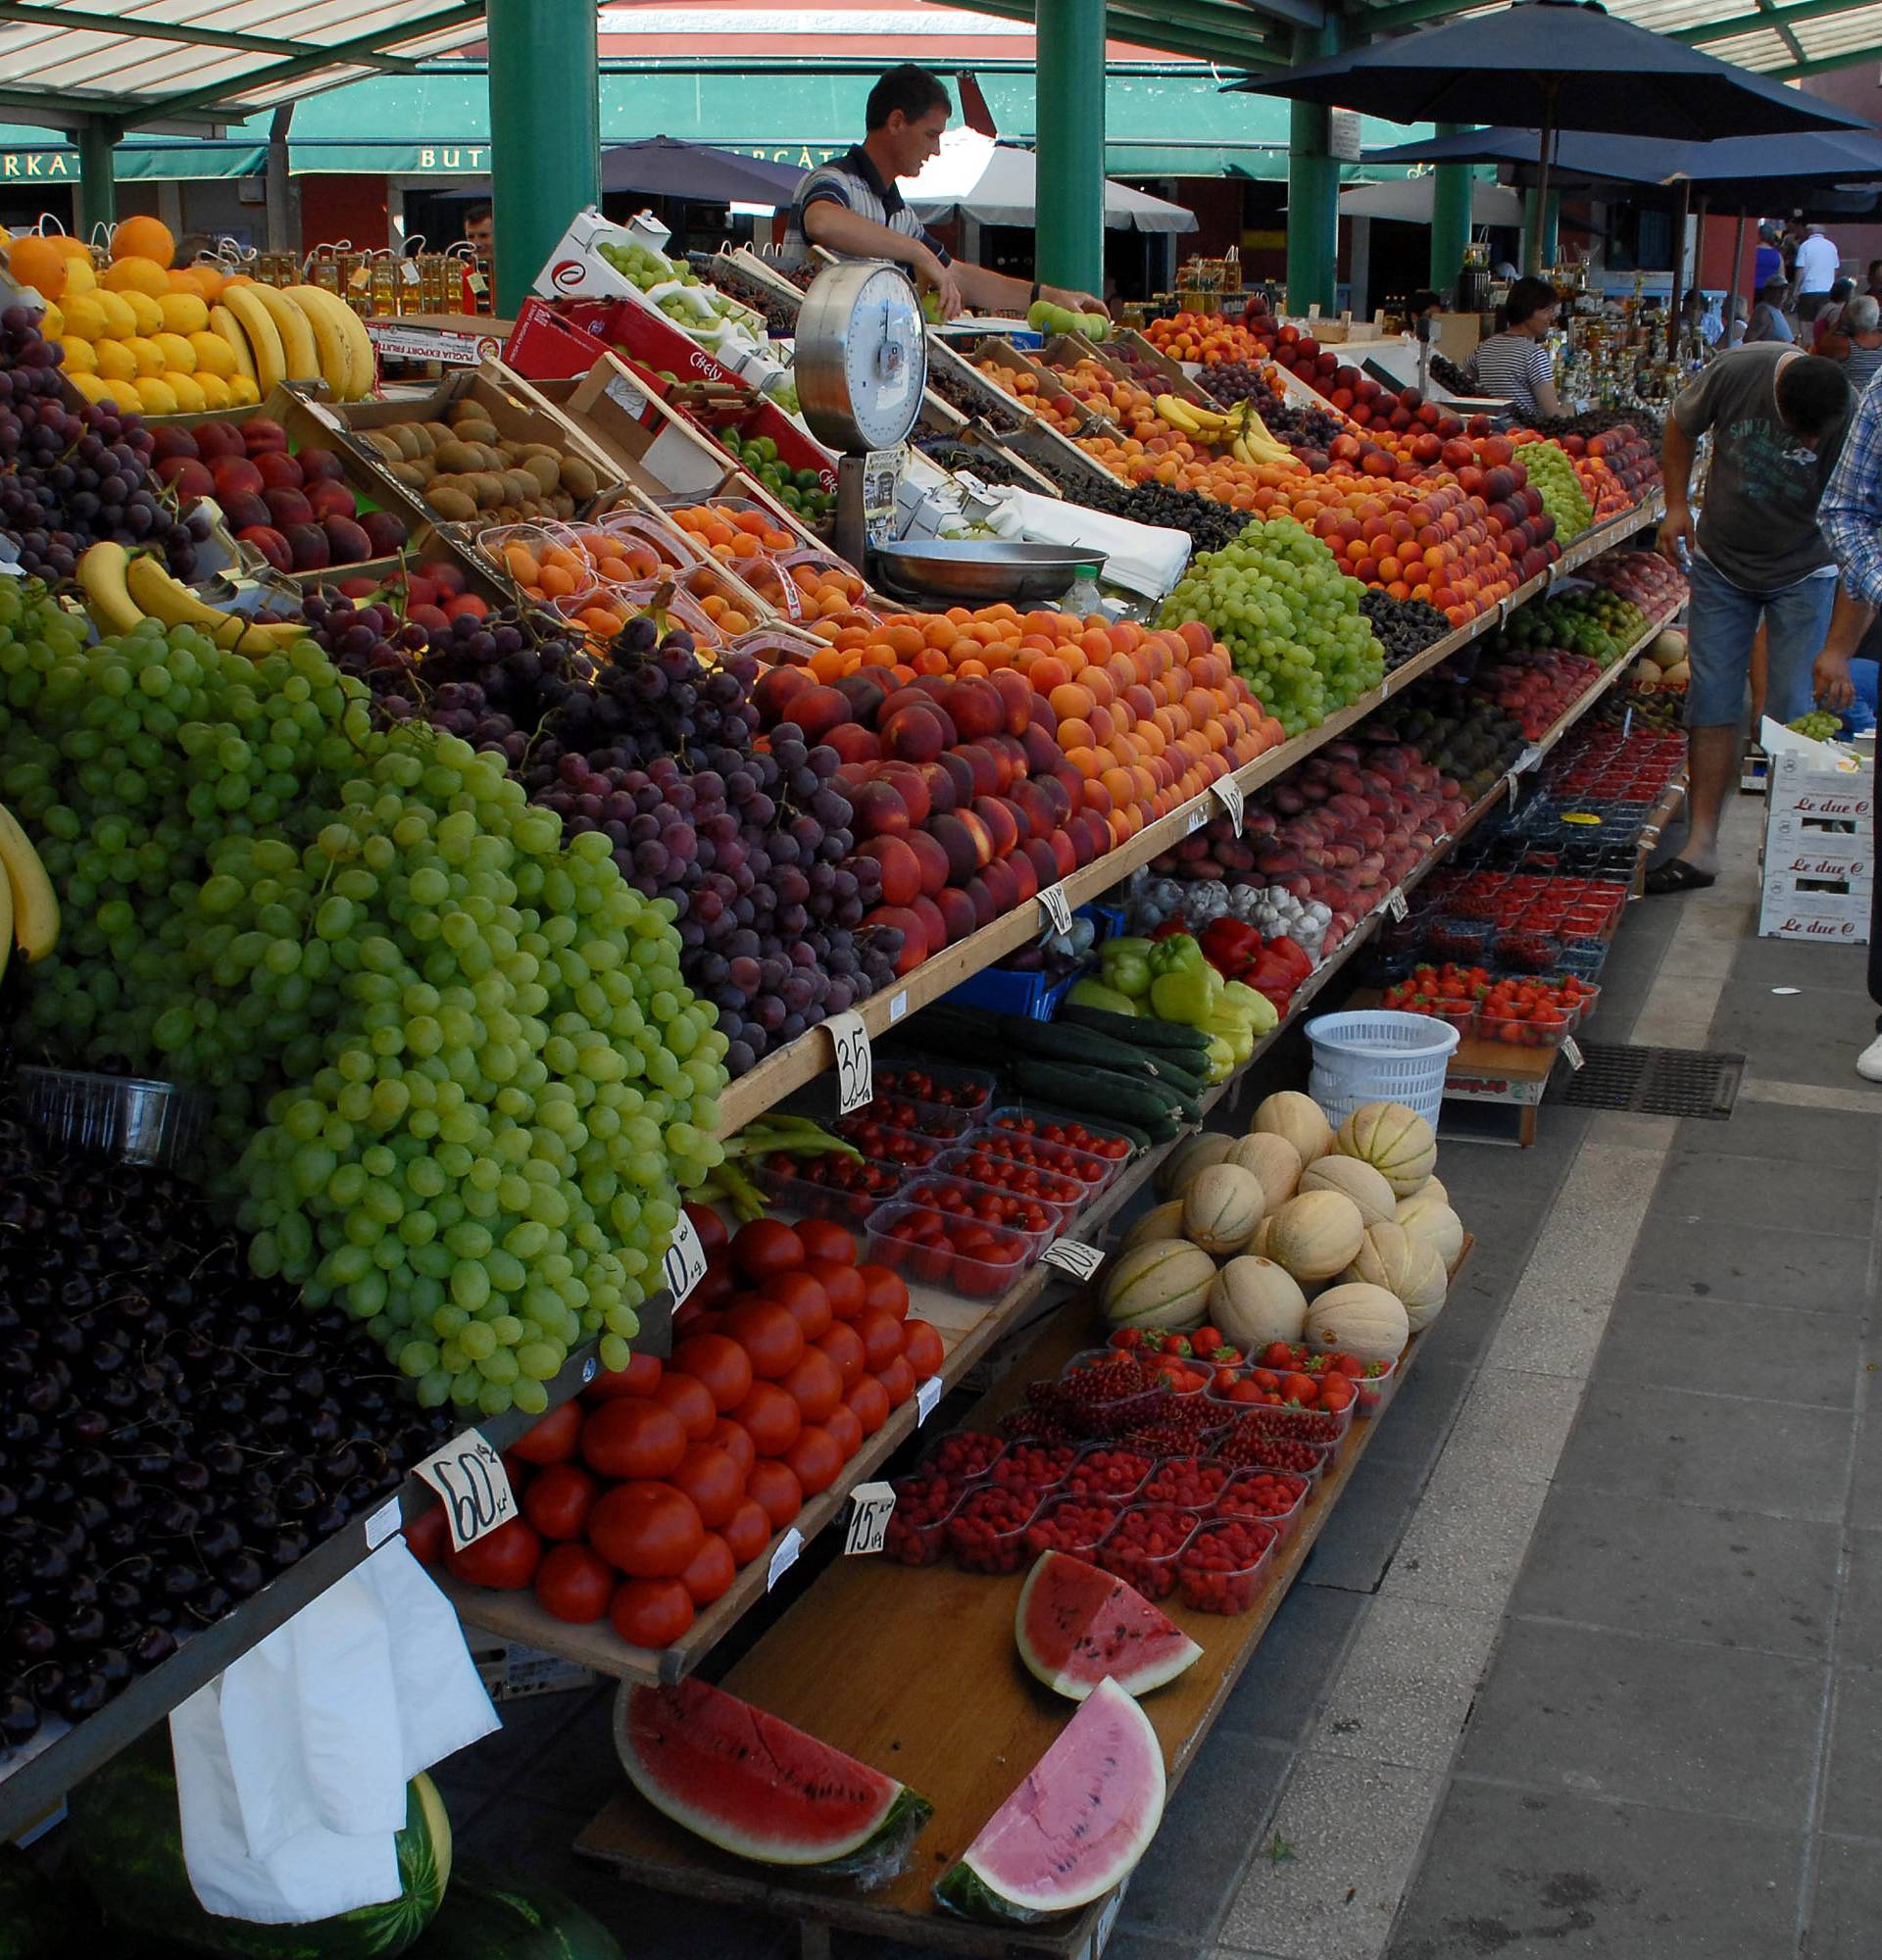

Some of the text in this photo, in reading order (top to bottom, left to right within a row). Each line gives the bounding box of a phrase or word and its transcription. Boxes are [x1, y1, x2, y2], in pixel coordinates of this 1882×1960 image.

[381, 343, 473, 362] PUGLIA EXPORT FRUIT
[1793, 797, 1816, 812] Le
[1820, 798, 1851, 813] due
[1789, 858, 1811, 872] Le
[1815, 858, 1846, 874] due
[1780, 917, 1803, 933] Le
[1806, 919, 1837, 935] due
[837, 1027, 868, 1106] 35
[433, 1452, 497, 1543] 60
[850, 1500, 878, 1553] 15
